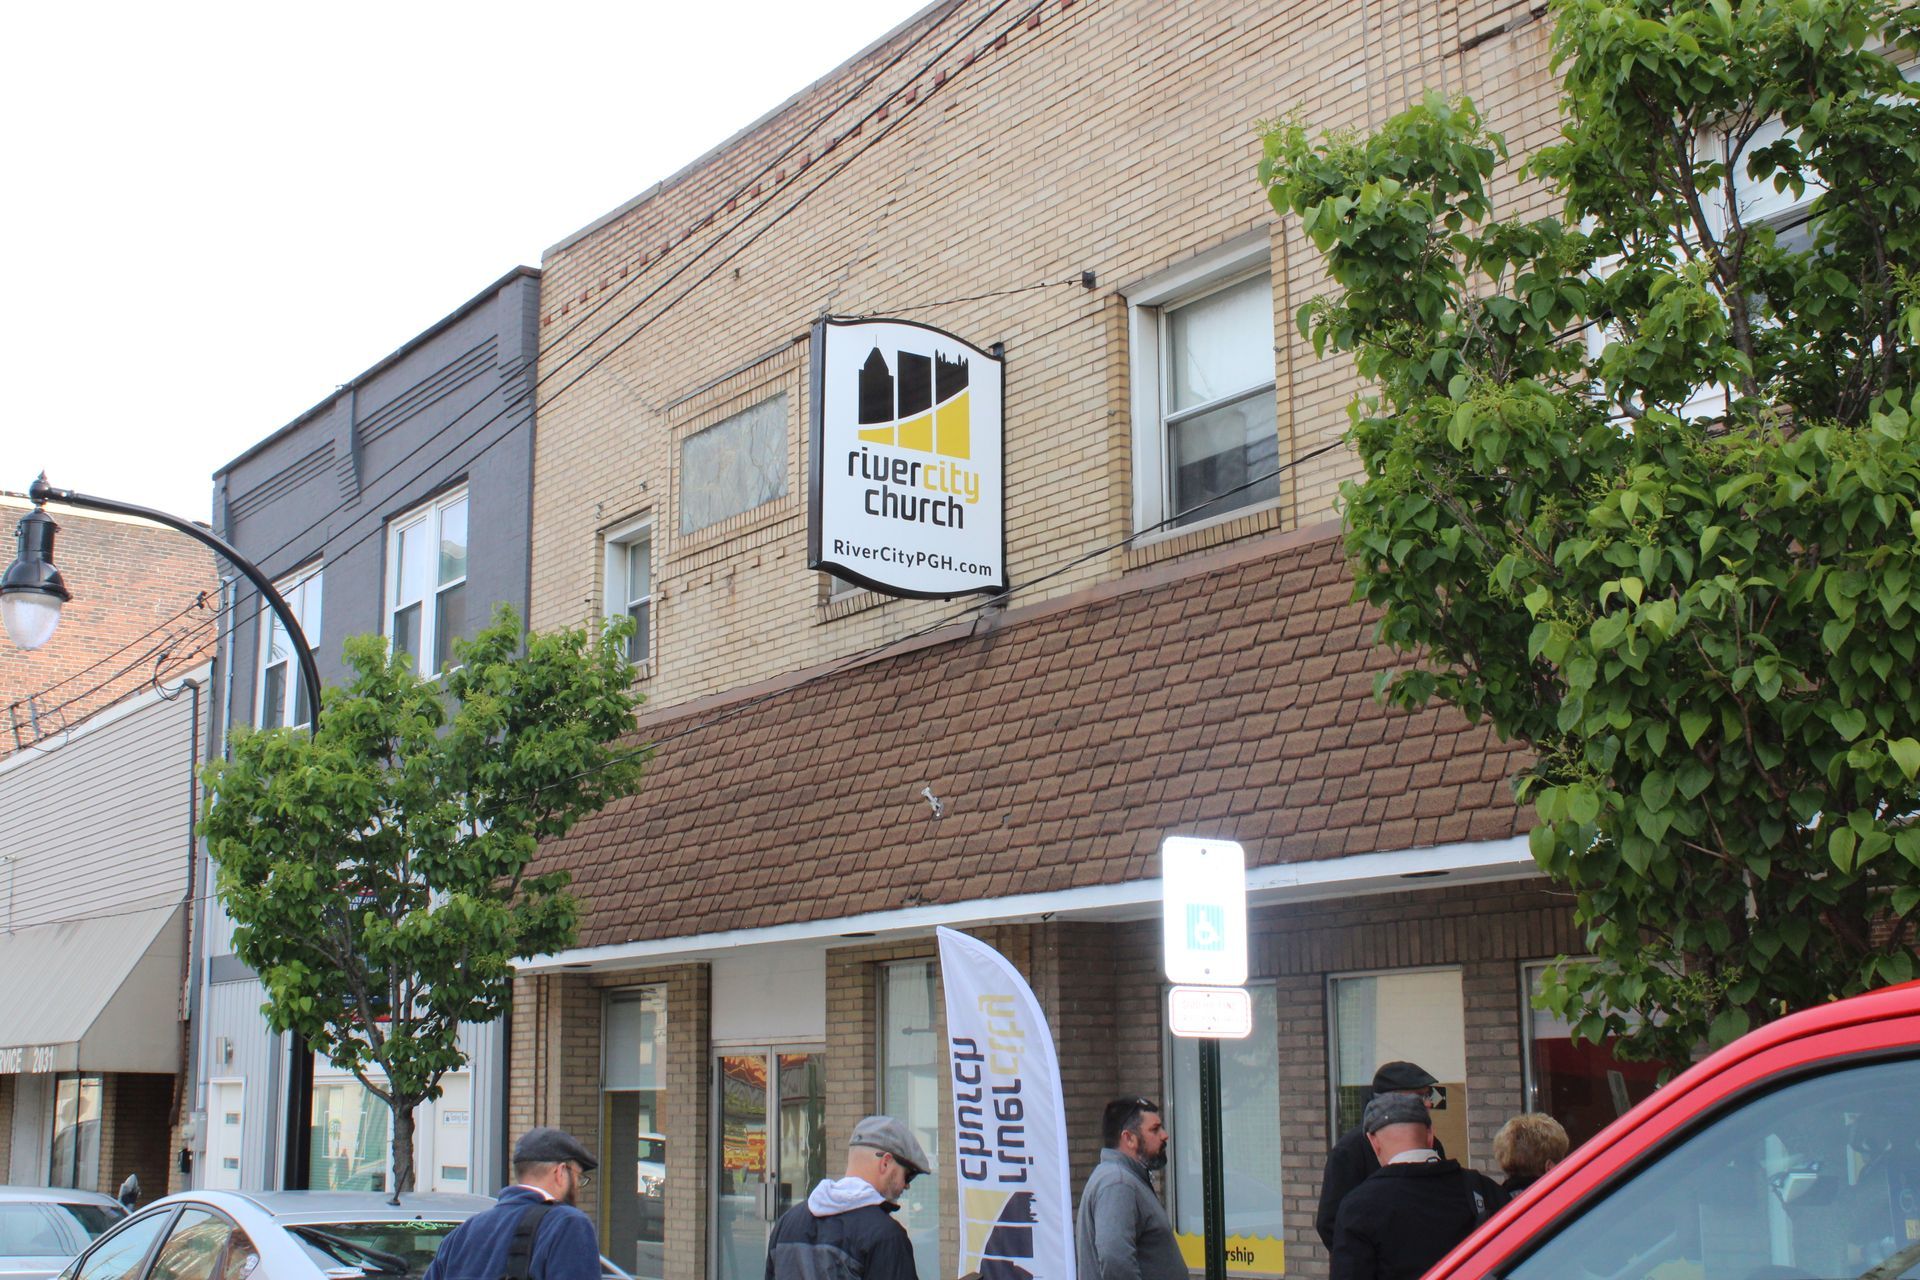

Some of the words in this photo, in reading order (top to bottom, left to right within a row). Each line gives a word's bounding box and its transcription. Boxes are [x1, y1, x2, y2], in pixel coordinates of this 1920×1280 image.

[865, 485, 964, 529] church
[834, 539, 992, 577] RiverCityPGH.com
[32, 1046, 54, 1073] 2031
[952, 1037, 993, 1181] church
